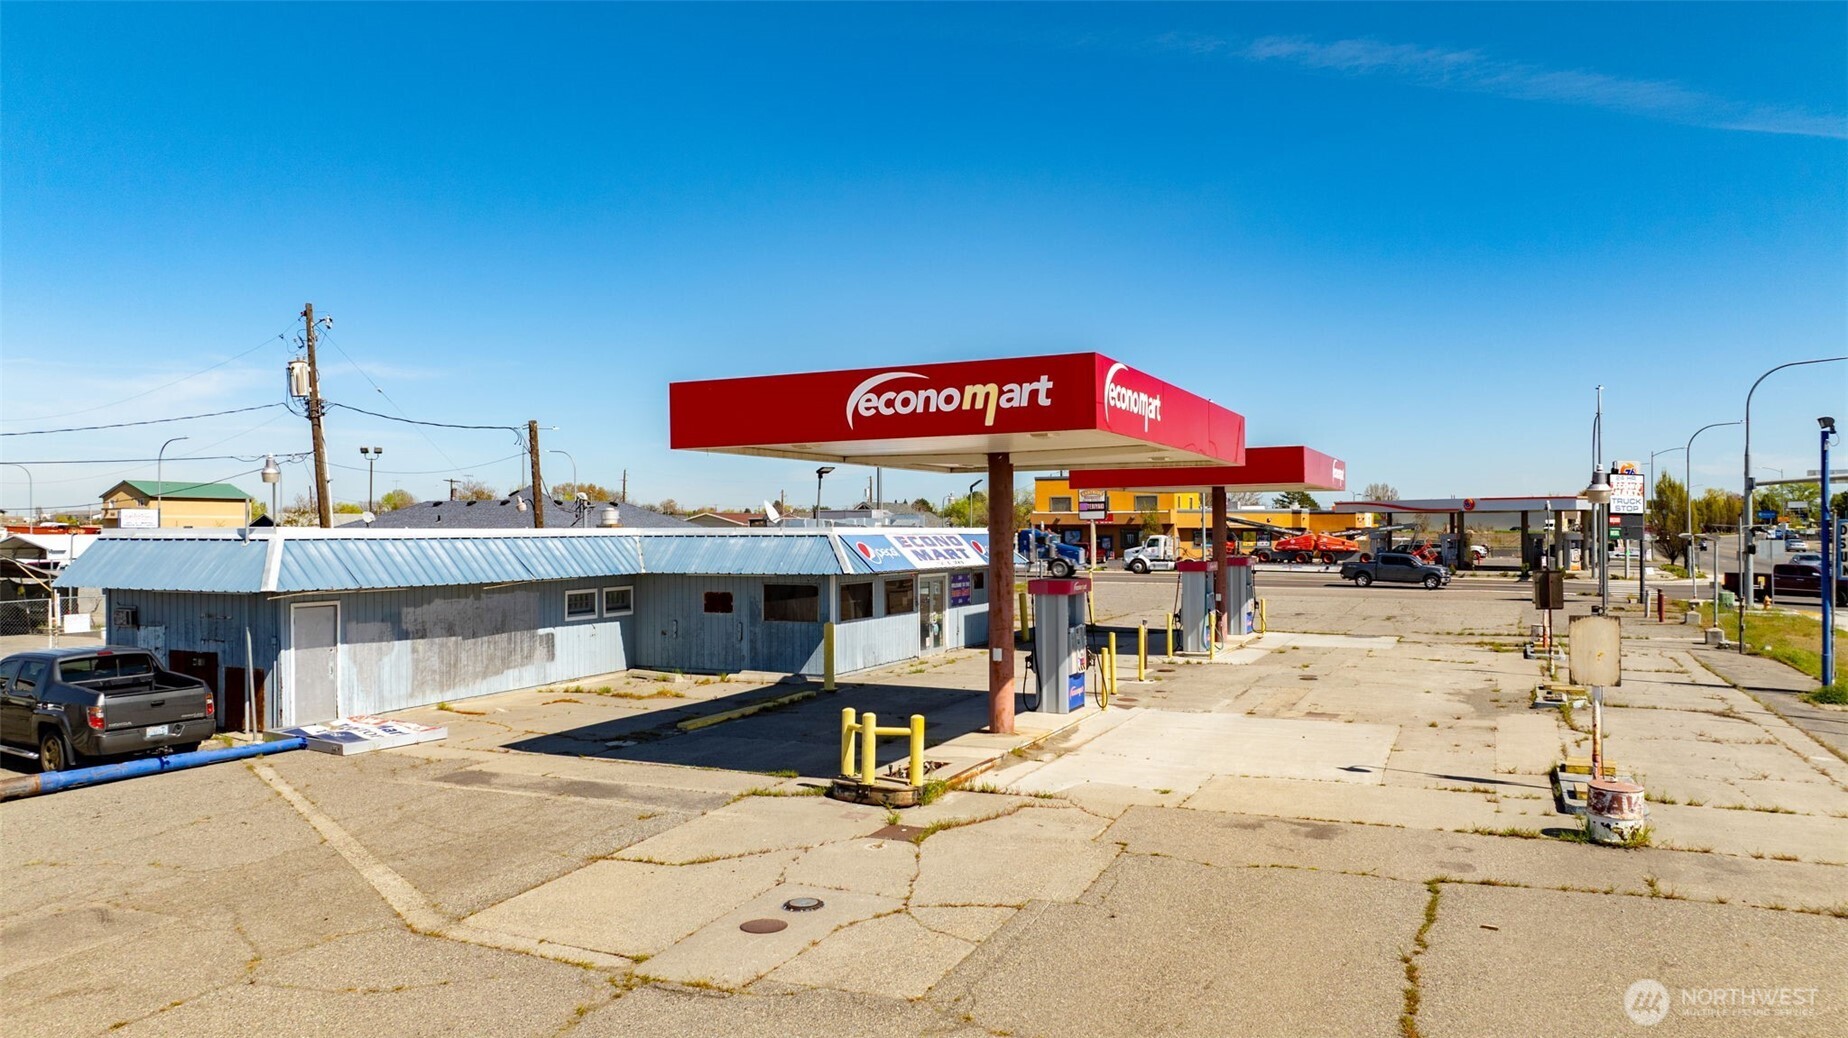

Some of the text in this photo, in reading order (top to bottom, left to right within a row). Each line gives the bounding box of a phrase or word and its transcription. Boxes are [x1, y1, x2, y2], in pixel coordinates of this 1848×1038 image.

[857, 374, 1053, 427] economart
[1108, 379, 1161, 433] economart
[1611, 497, 1642, 505] TRUCK
[893, 535, 964, 548] ECONO
[910, 548, 971, 562] MART
